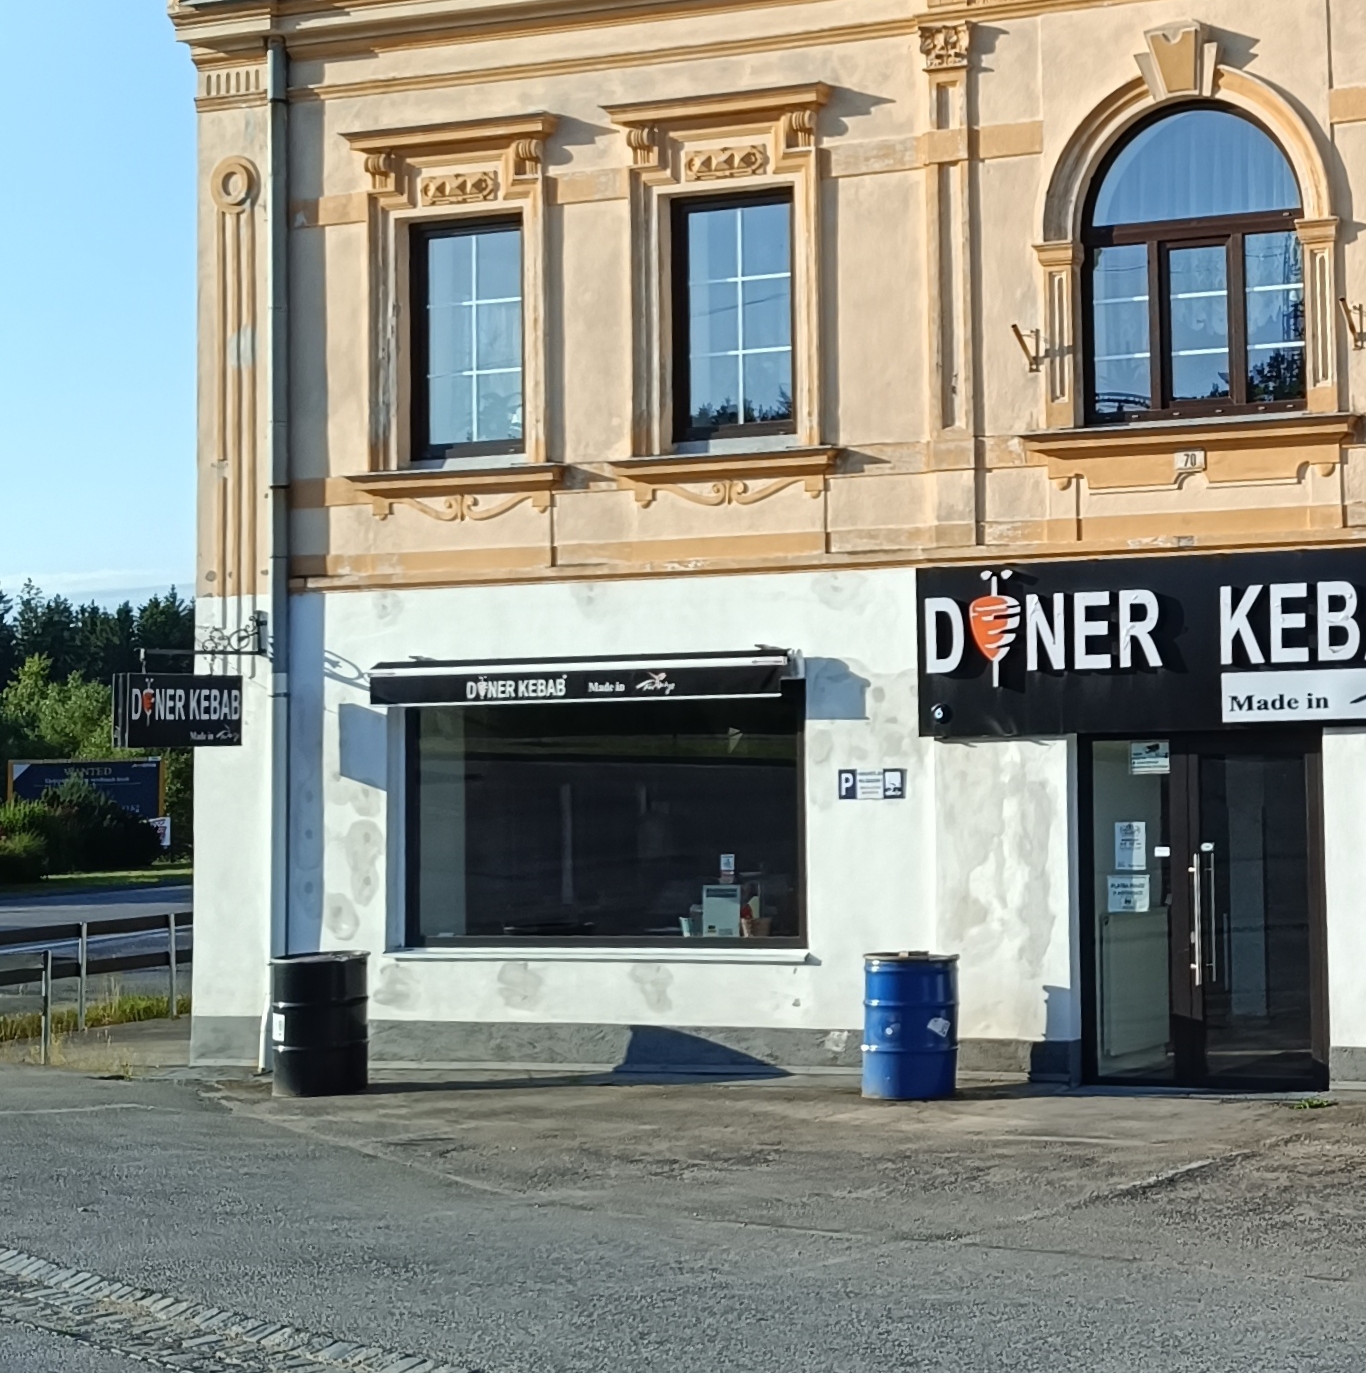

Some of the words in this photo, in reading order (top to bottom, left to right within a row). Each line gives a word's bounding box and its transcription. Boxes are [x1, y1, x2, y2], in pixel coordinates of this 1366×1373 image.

[1183, 453, 1197, 467] 70
[517, 679, 567, 699] KEBAB
[588, 682, 614, 693] Made
[615, 680, 626, 692] in
[189, 689, 241, 721] KEBAB
[1228, 693, 1300, 712] Made
[1306, 692, 1330, 709] in
[840, 772, 854, 796] P
